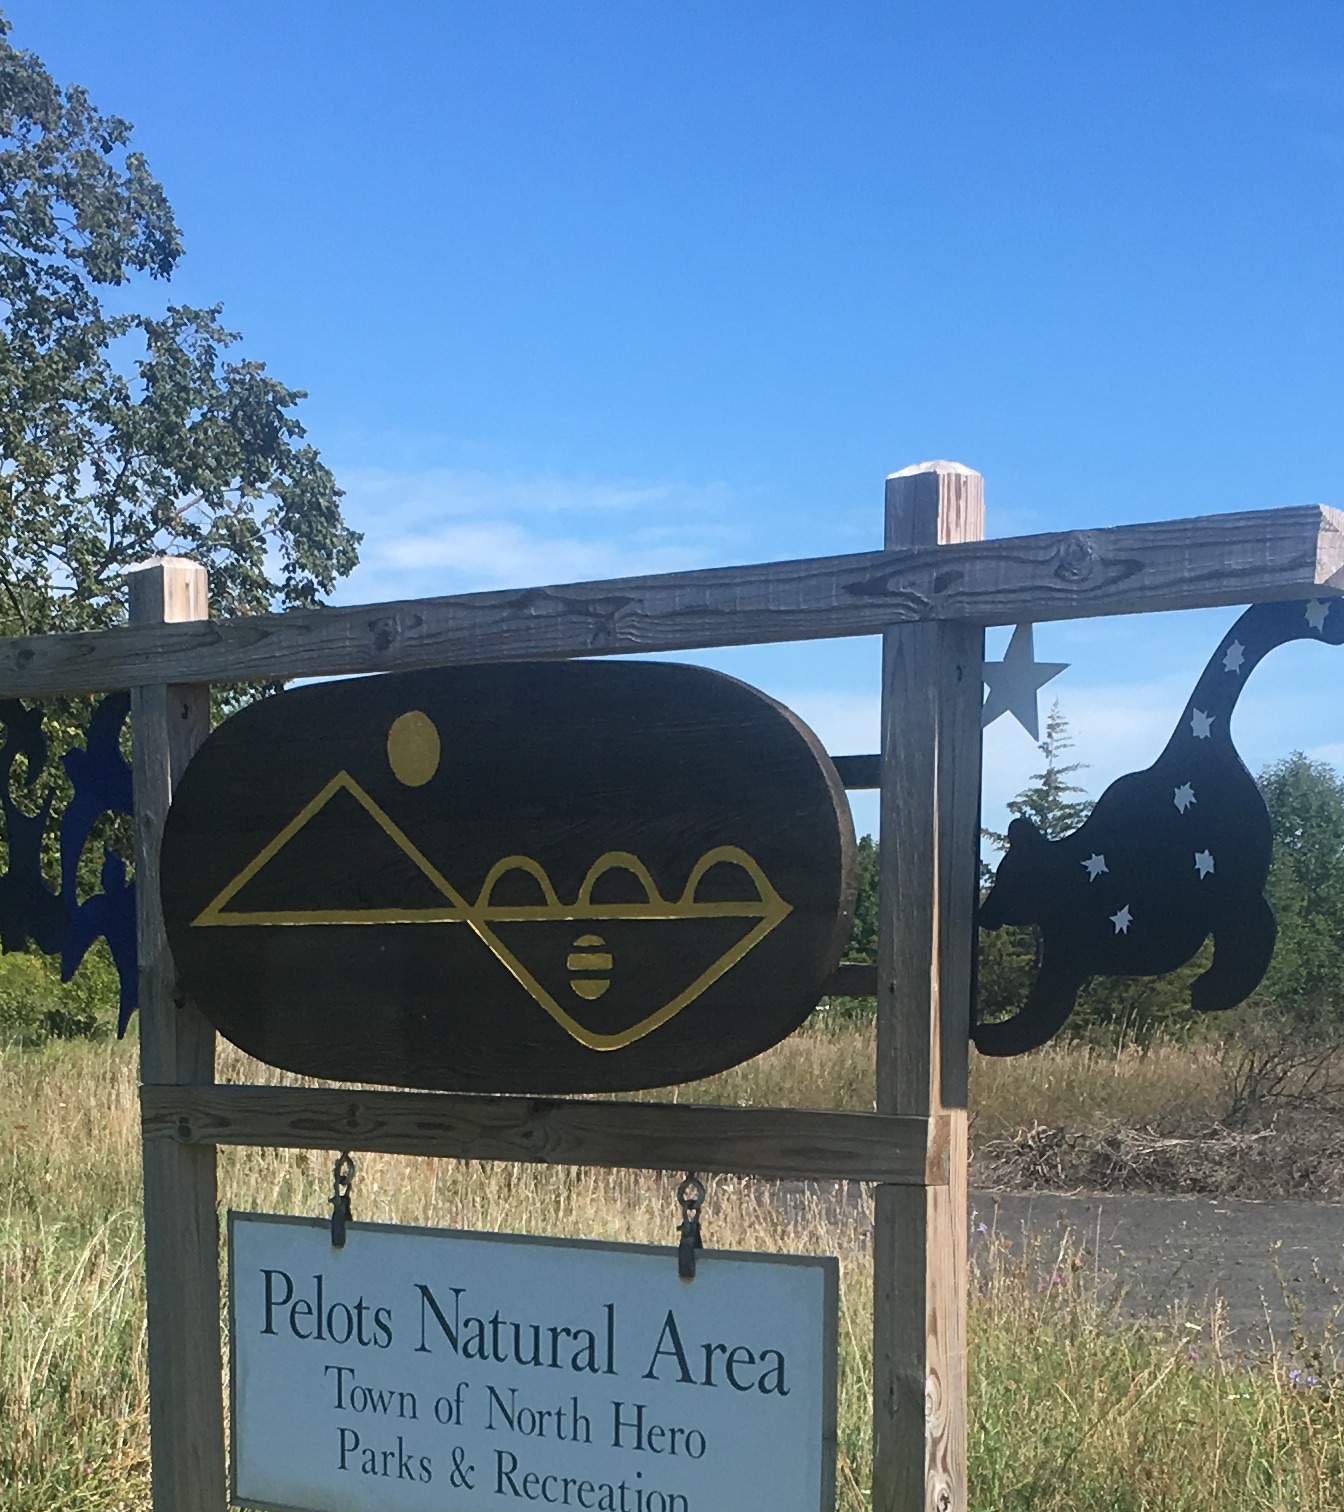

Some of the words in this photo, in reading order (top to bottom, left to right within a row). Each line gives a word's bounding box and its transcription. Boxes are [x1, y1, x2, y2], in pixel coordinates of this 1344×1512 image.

[259, 1268, 393, 1349] Pelots
[413, 1283, 619, 1376] Natural
[640, 1309, 791, 1397] Area
[323, 1364, 419, 1420] Town
[434, 1381, 470, 1426] of
[484, 1384, 593, 1444] North
[610, 1400, 707, 1460] Hero
[336, 1426, 432, 1484] Parks
[449, 1445, 476, 1491] &
